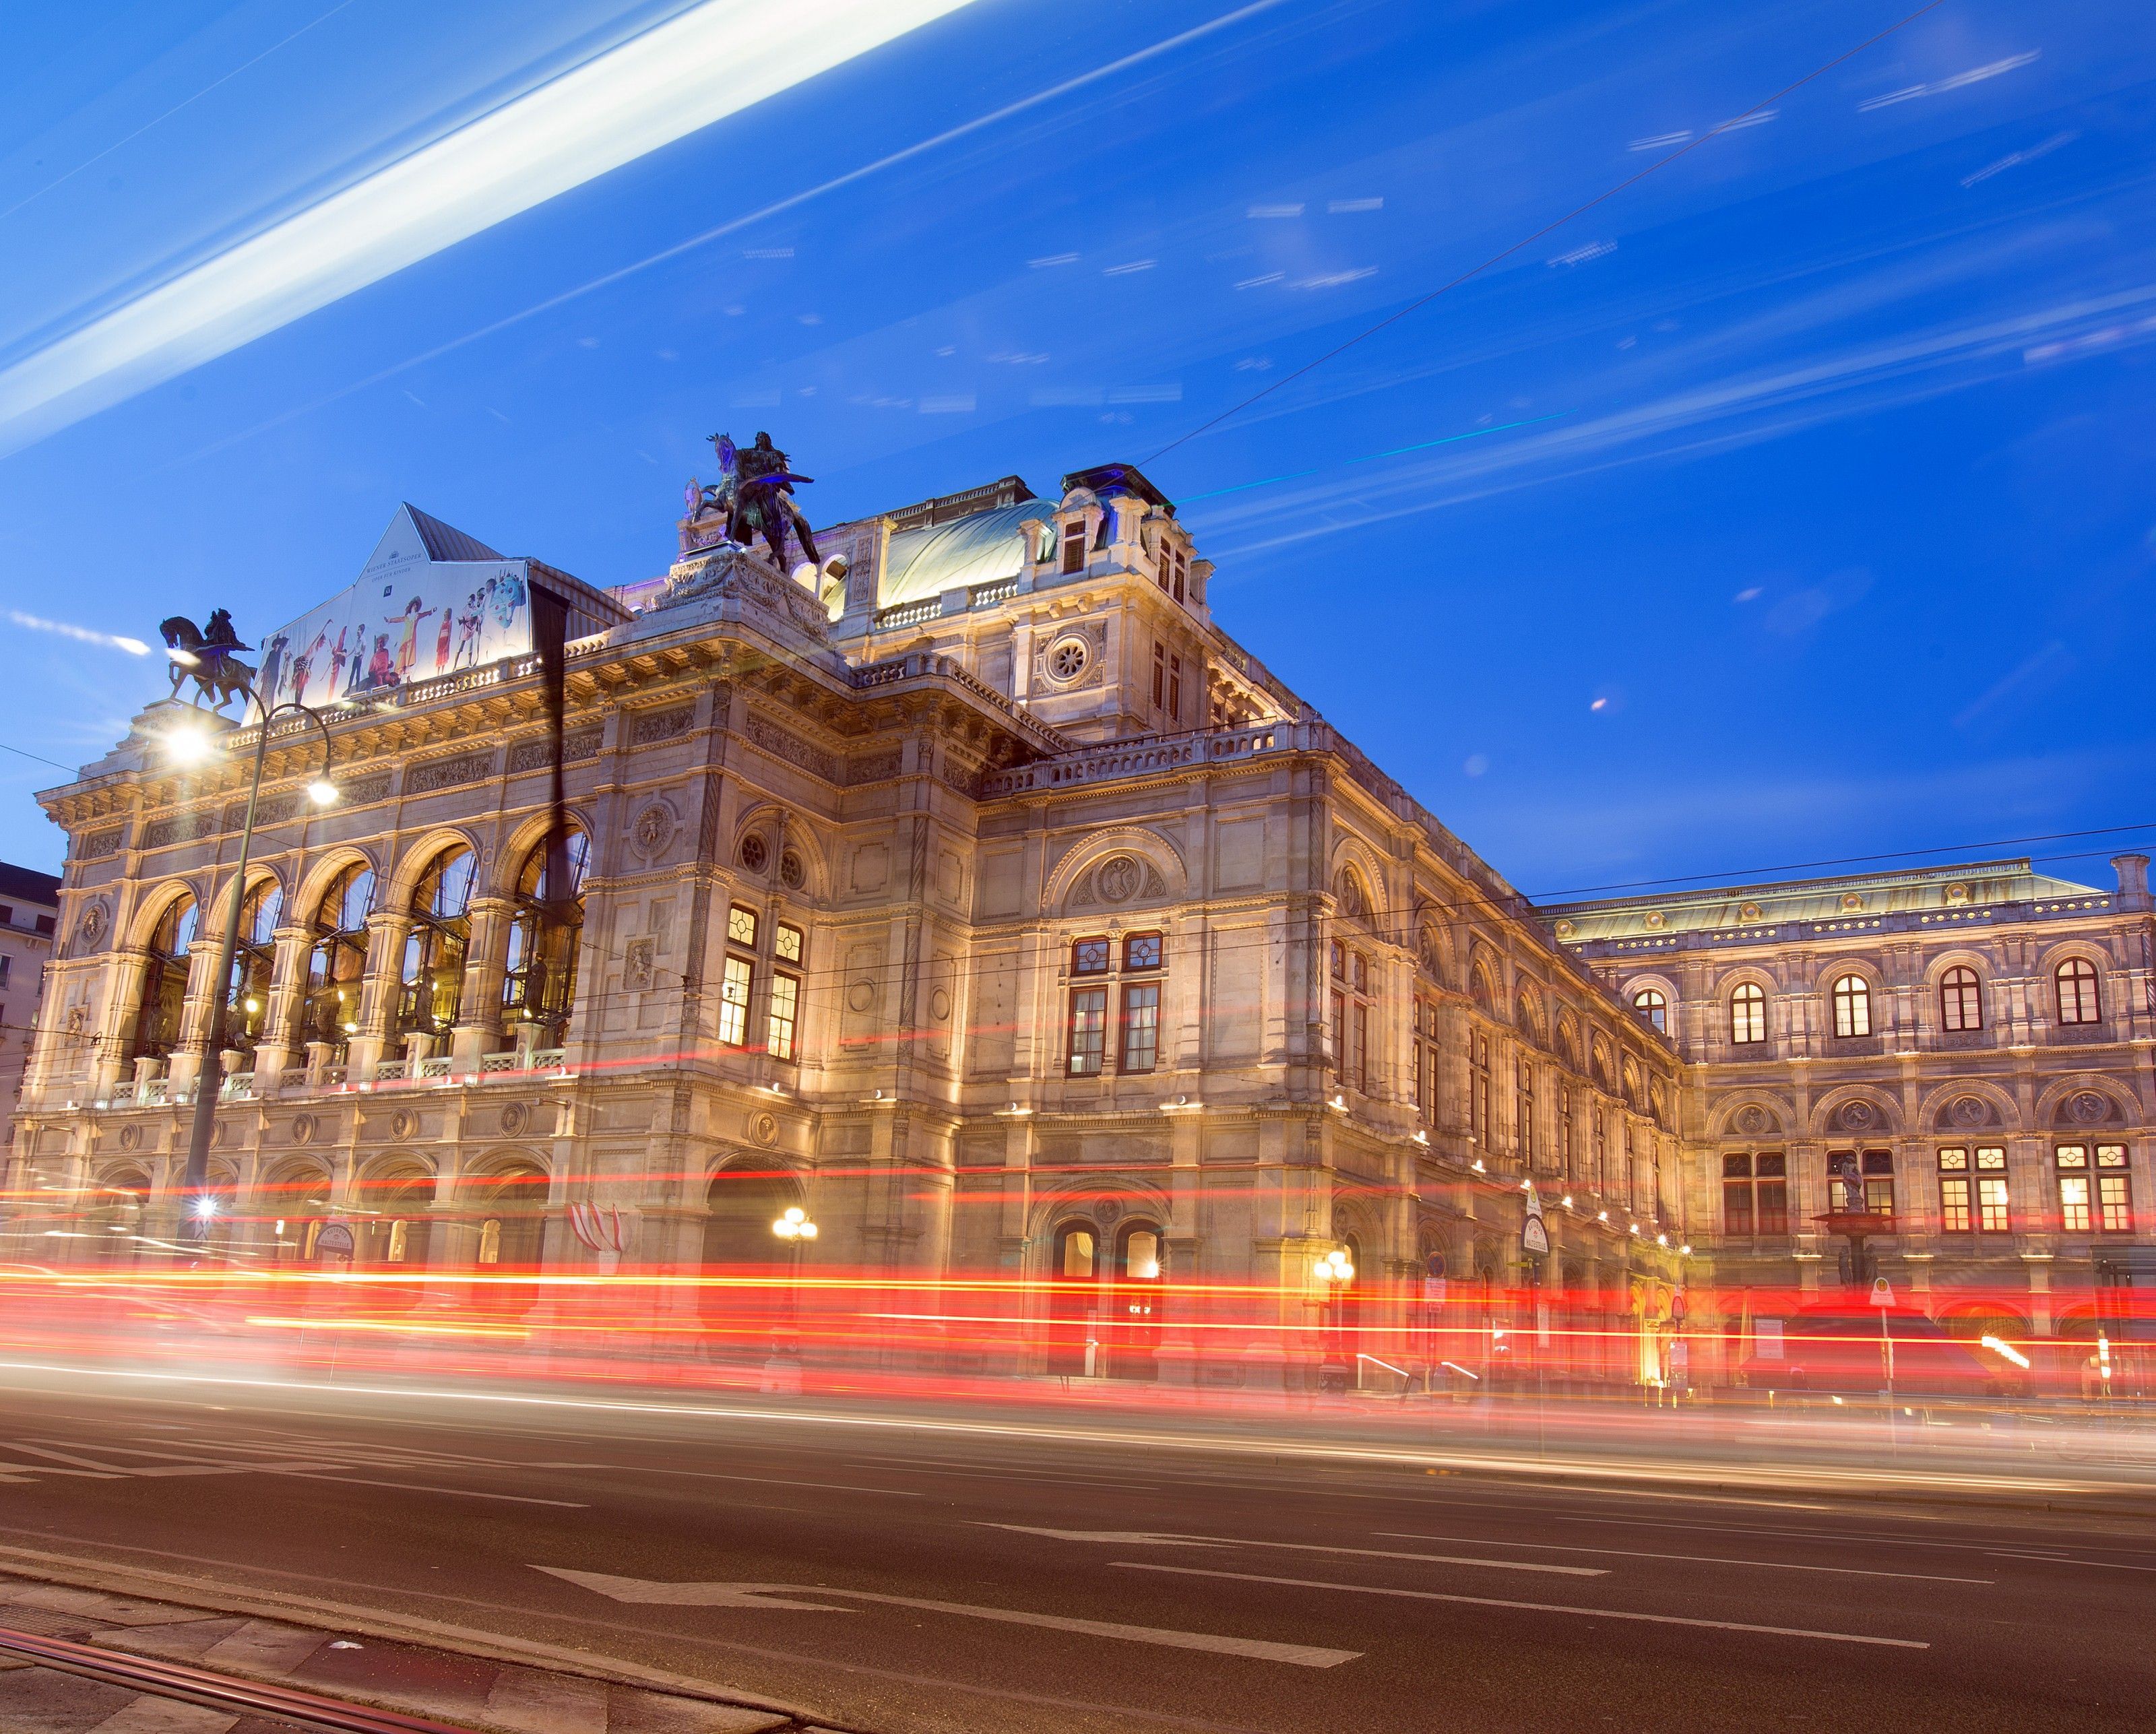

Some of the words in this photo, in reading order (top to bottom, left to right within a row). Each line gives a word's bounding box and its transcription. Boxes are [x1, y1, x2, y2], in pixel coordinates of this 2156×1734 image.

[367, 563, 387, 573] WIENER
[387, 553, 422, 566] STAATSOPER
[327, 1227, 348, 1238] AUTOBUS
[1528, 1220, 1543, 1235] AUTOBUS
[321, 1239, 350, 1248] HALTESTELLE
[1526, 1239, 1546, 1251] HALTESTELLE
